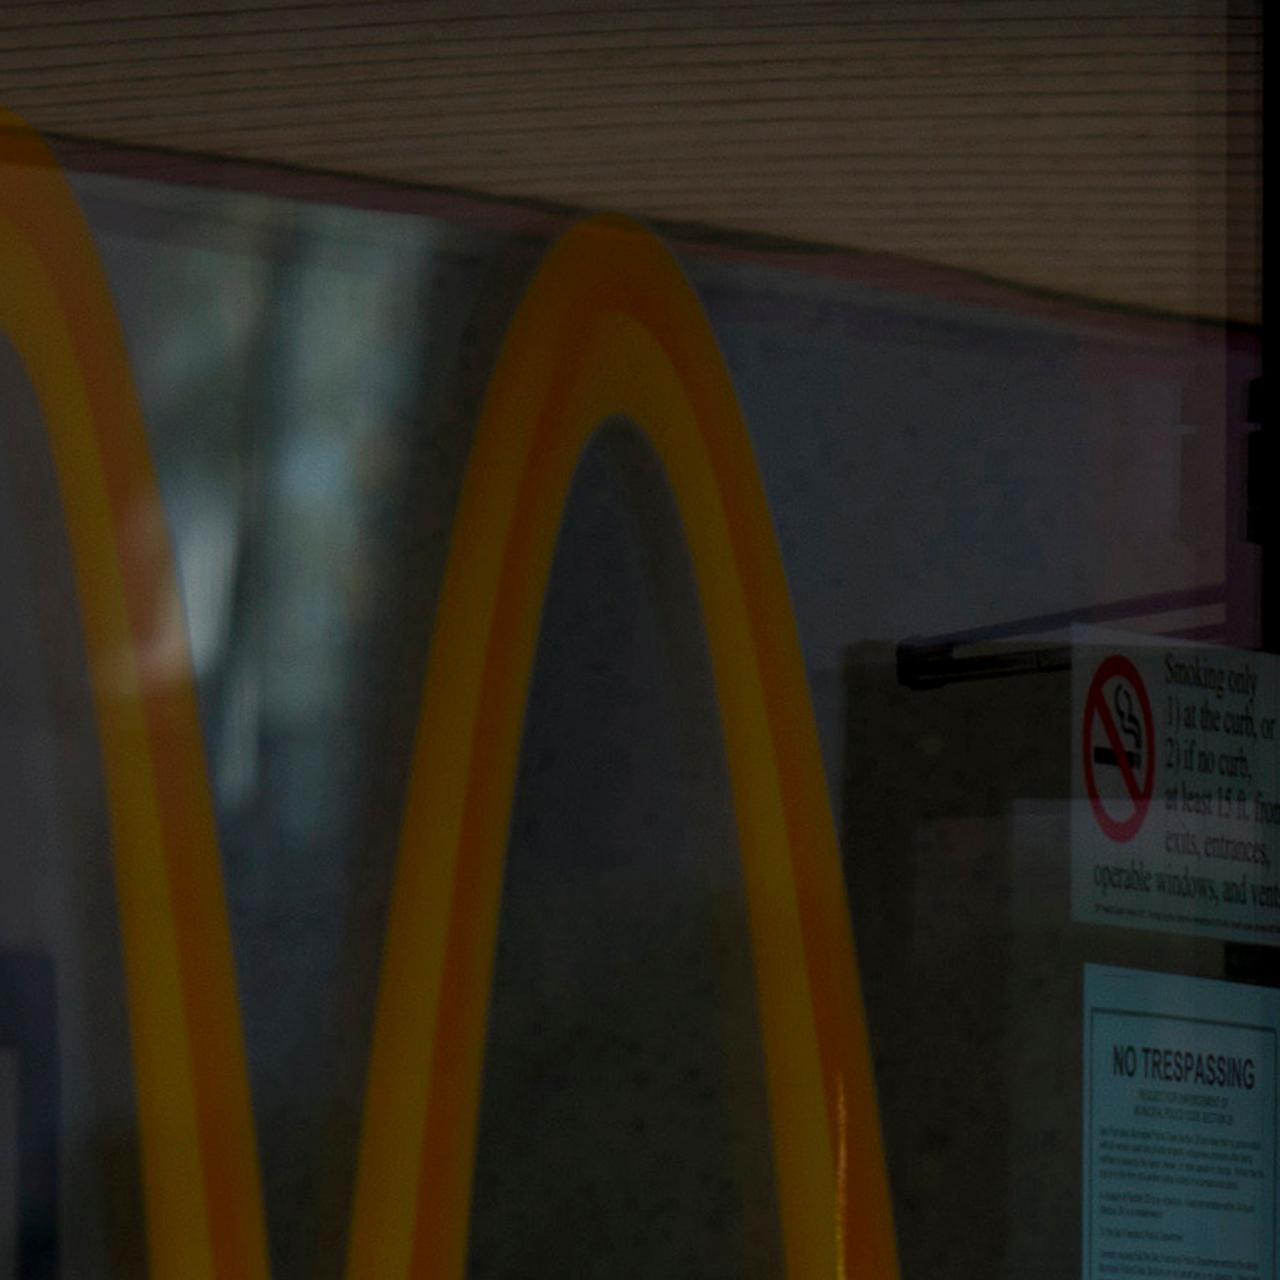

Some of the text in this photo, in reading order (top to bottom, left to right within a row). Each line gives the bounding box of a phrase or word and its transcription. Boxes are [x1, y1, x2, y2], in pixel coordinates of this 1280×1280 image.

[1164, 651, 1257, 703] Smoking only
[1183, 703, 1197, 729] at
[1200, 700, 1220, 733] the
[1260, 716, 1276, 740] or
[1184, 738, 1197, 770] if
[1198, 750, 1215, 775] no
[1164, 787, 1178, 811] at
[1182, 781, 1212, 816] least
[1093, 860, 1152, 896] operable
[1222, 874, 1248, 904] and
[1113, 1045, 1256, 1090] NO TRESPASSING
